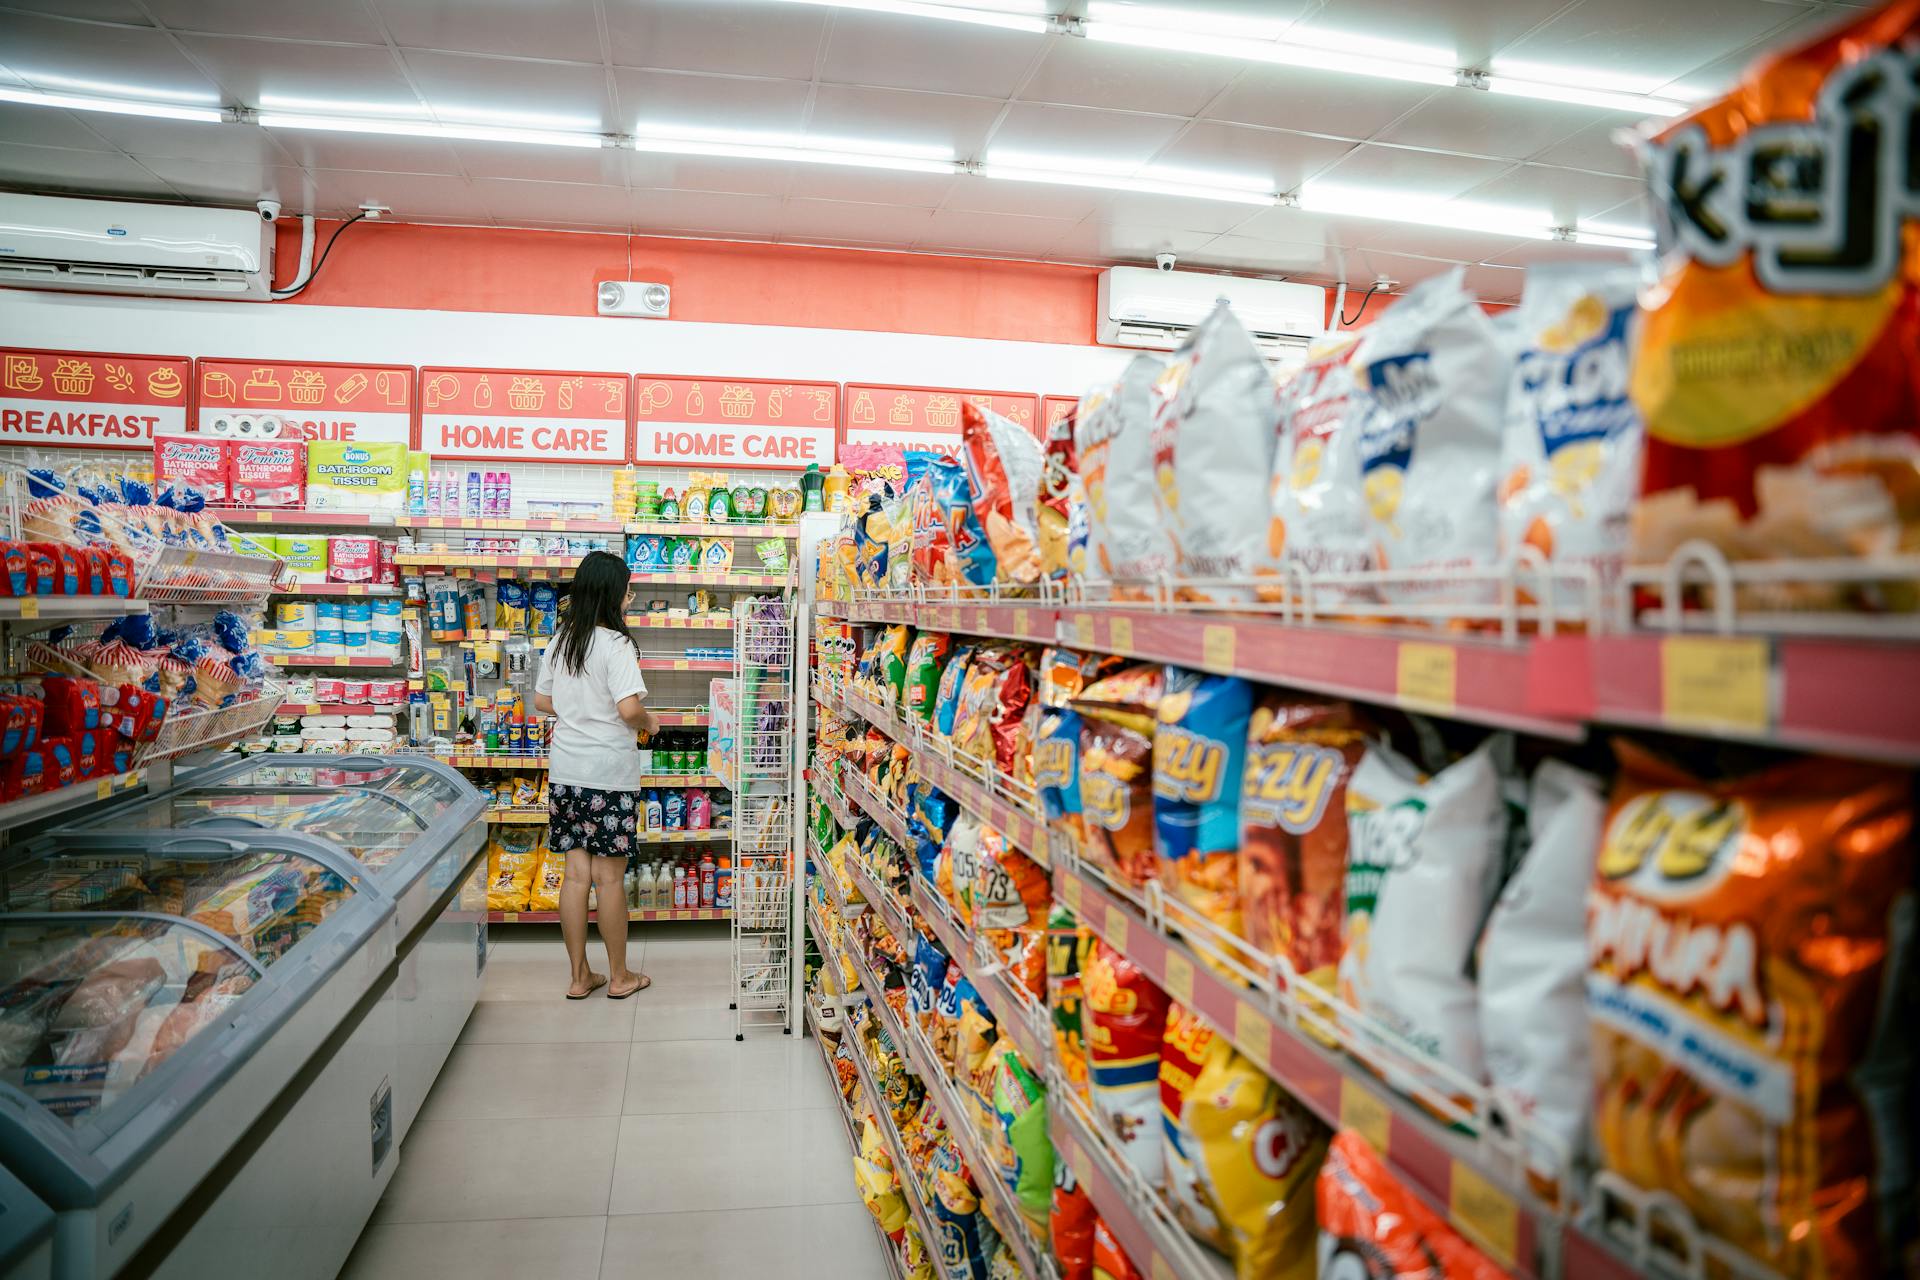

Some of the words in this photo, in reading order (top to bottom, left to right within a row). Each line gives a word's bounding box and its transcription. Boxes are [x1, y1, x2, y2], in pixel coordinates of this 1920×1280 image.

[2, 408, 160, 439] REAKFAST
[302, 420, 357, 442] SUE
[441, 424, 524, 450] HOME
[535, 426, 609, 452] CARE
[654, 431, 734, 457] HOME
[742, 433, 817, 459] CARE
[856, 440, 961, 459] NDRY
[161, 442, 220, 463] Femme
[236, 444, 294, 466] Femme
[345, 452, 370, 462] BONUS
[163, 461, 218, 471] BATHROOM
[163, 467, 196, 476] TISSUE
[239, 464, 292, 473] BATHROOM
[318, 465, 392, 476] BATHROOM
[239, 471, 270, 480] TISSUE
[331, 476, 377, 486] TISSUE
[243, 489, 252, 498] 9
